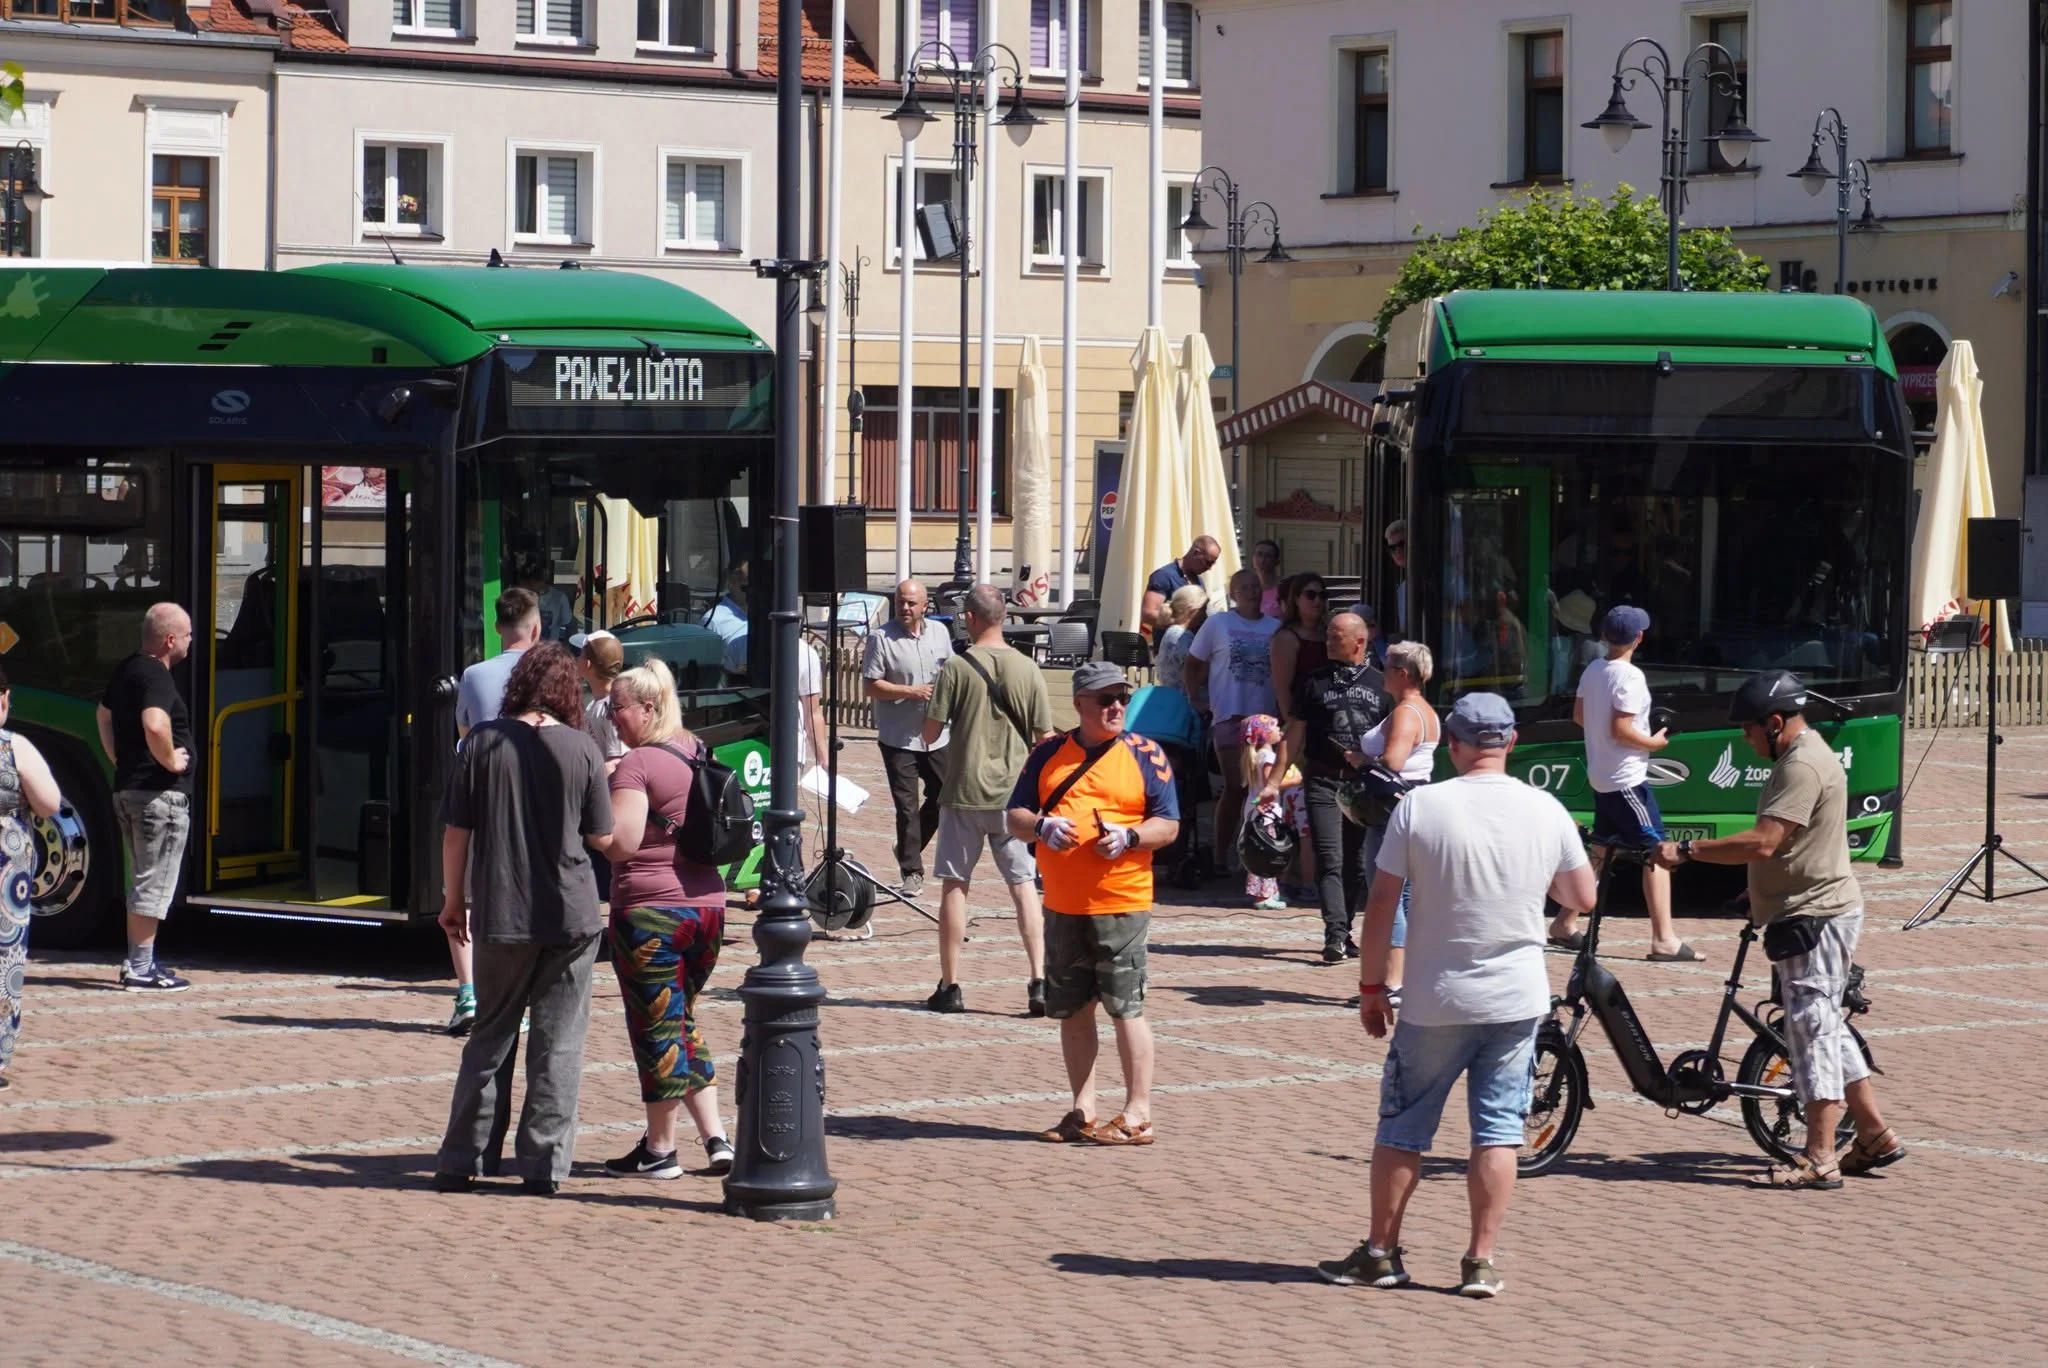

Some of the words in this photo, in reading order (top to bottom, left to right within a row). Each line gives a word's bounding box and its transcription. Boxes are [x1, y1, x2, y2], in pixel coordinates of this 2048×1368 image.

[1102, 506, 1116, 515] PEP
[1528, 764, 1570, 790] 07
[1744, 765, 1772, 781] ŻOR
